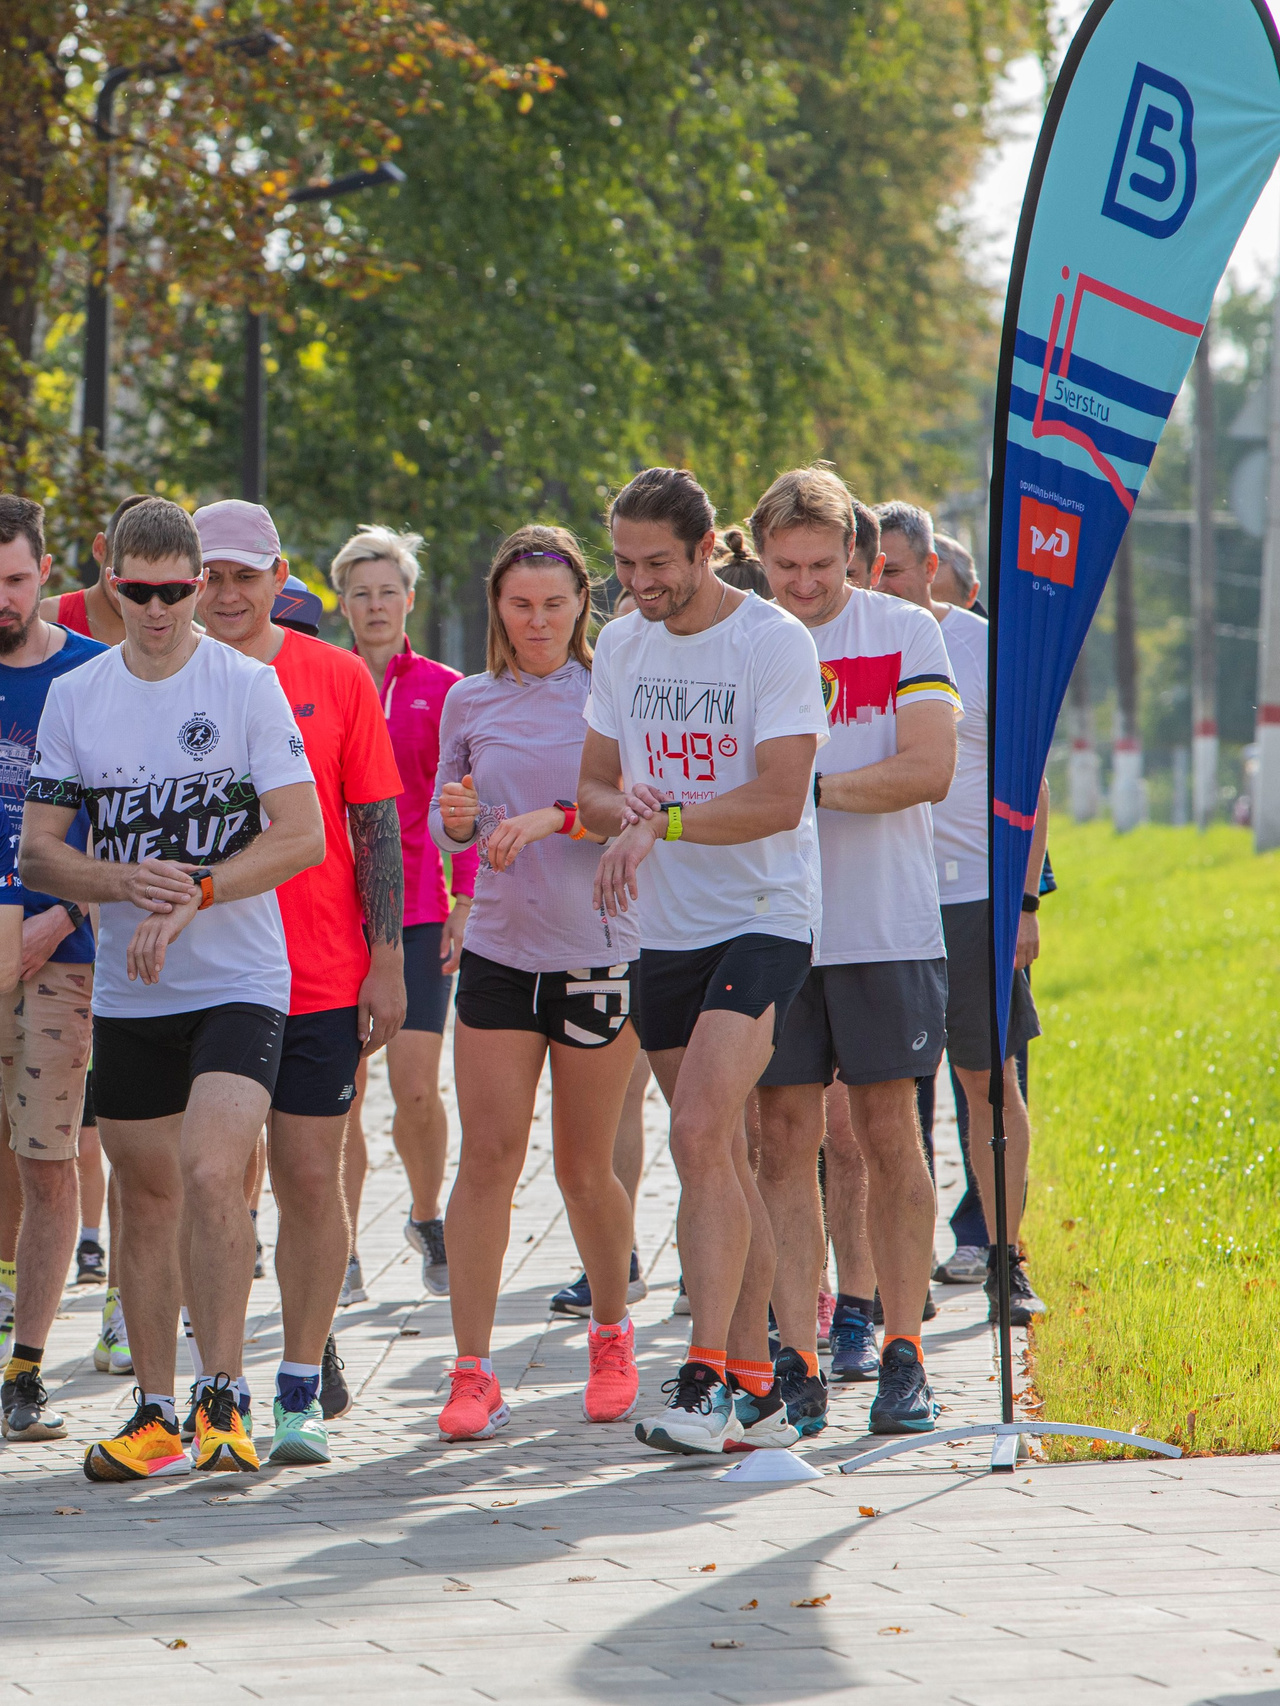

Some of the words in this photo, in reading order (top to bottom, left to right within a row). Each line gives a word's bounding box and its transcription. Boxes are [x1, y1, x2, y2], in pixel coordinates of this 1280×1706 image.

[1054, 380, 1110, 422] 5verst.ru
[639, 676, 695, 685] ПОЛУМАРАФОН
[181, 717, 204, 730] GOLDEN
[205, 718, 217, 729] RING
[630, 684, 736, 724] ЛУЖНИКИ
[180, 745, 198, 757] ULTRA
[200, 744, 217, 756] TRAIL
[645, 731, 716, 781] 1:49
[97, 767, 235, 831] NEVER
[186, 809, 249, 856] UP
[604, 924, 613, 948] Reebok
